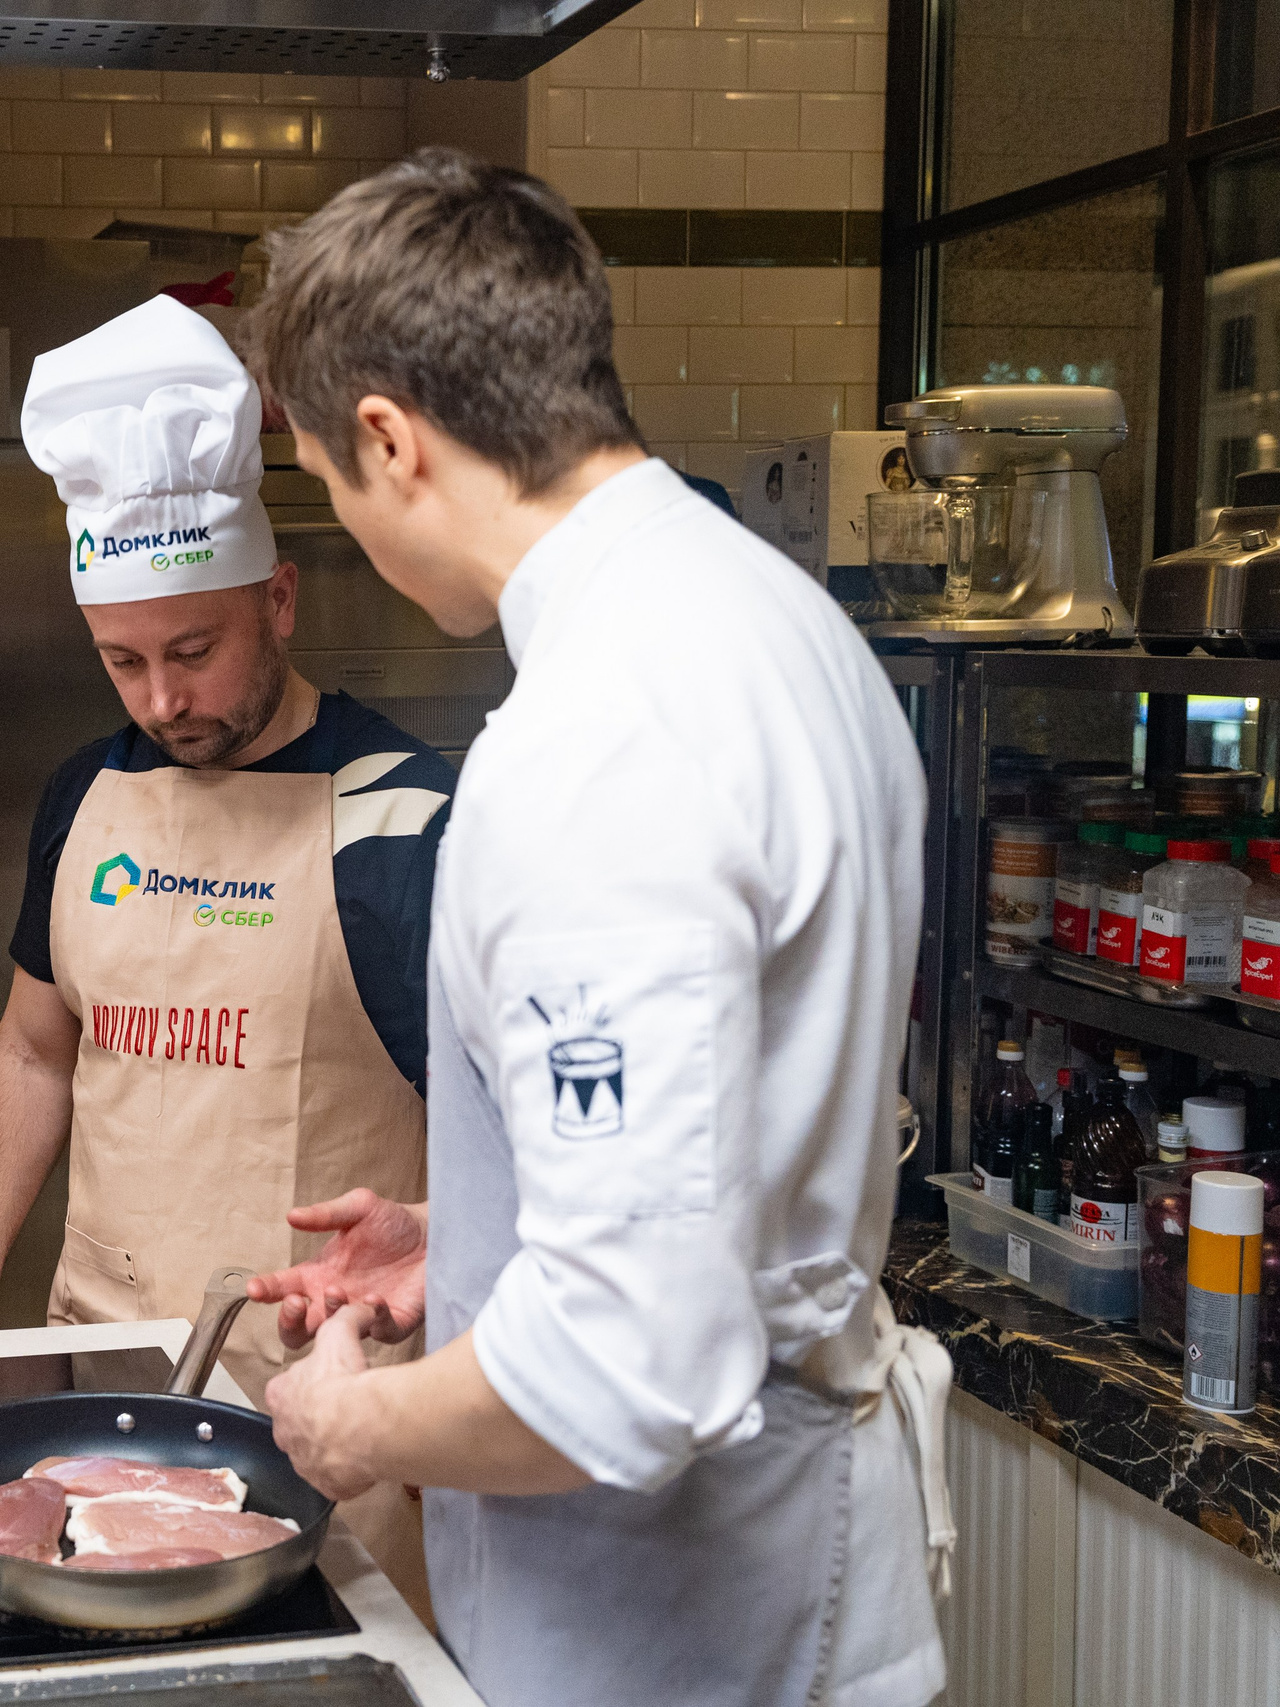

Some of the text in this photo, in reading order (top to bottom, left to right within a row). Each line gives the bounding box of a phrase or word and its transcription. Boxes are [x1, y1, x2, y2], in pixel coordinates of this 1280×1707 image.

[174, 549, 214, 565] СБЕР
[142, 868, 276, 900] Домклик
[220, 910, 274, 927] СБЕР
[92, 1004, 249, 1069] NOVIKOV SPACE
[1070, 1220, 1117, 1242] MIRIN
